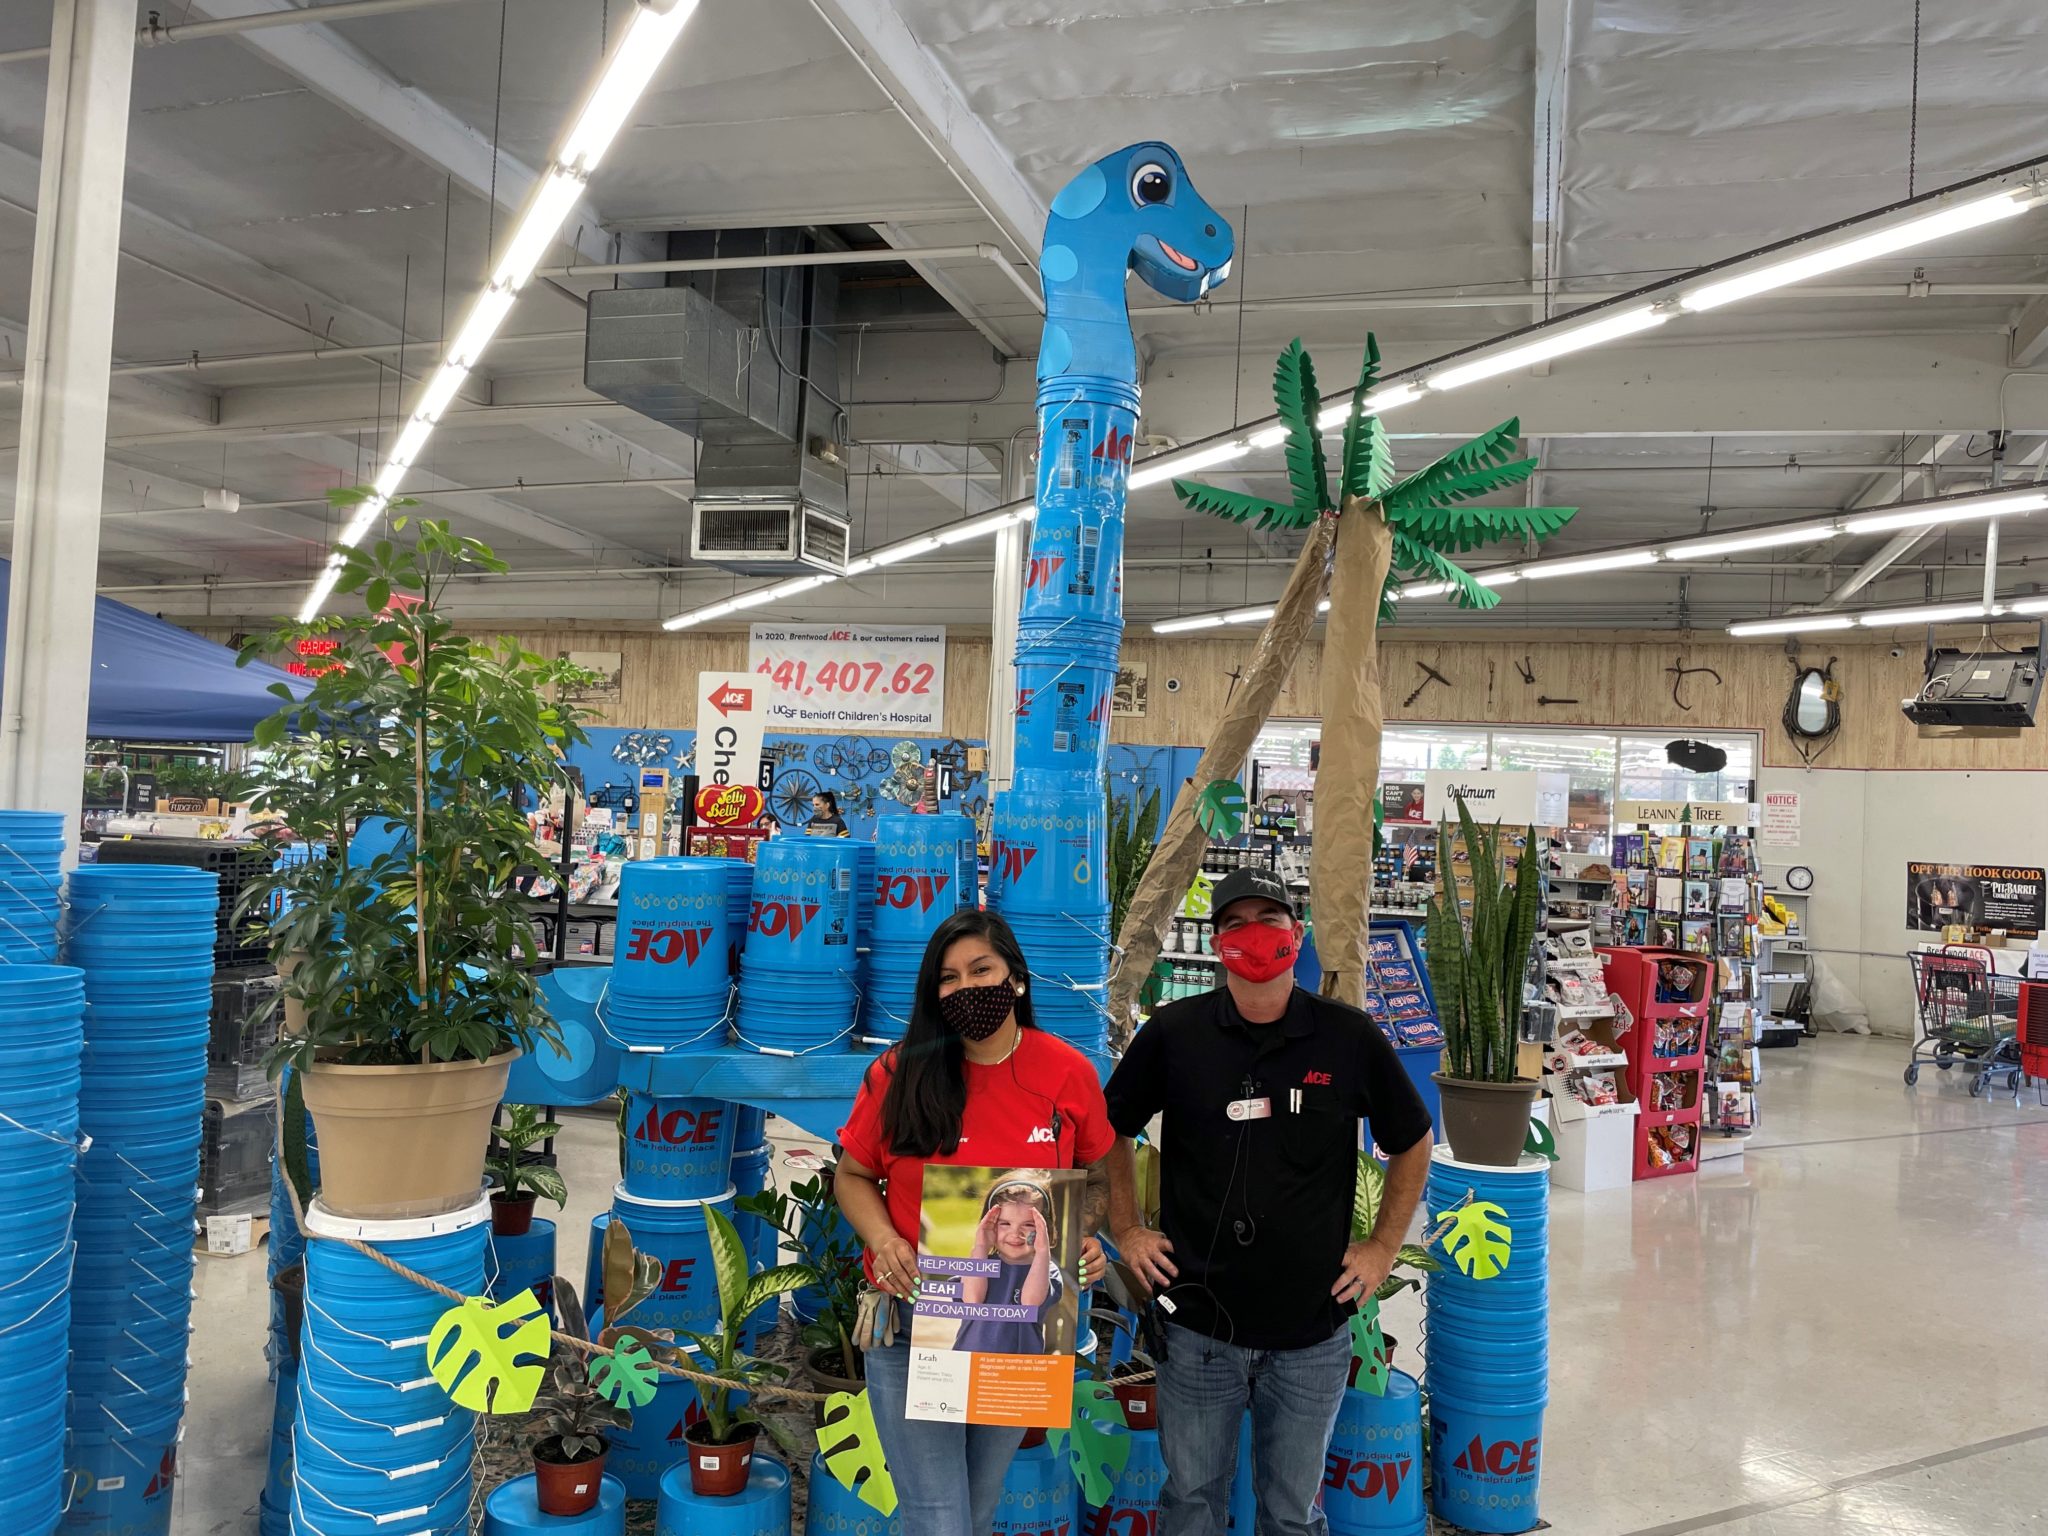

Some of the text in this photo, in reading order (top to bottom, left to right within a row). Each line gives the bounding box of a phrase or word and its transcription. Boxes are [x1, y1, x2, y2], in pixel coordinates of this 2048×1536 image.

[1092, 426, 1133, 465] AC
[765, 633, 787, 641] 2020,
[789, 633, 828, 642] Brentwood
[829, 630, 851, 641] ACE
[874, 635, 913, 643] customers
[915, 635, 940, 643] raised
[721, 692, 745, 704] ACE
[773, 705, 797, 719] UCSF
[800, 710, 836, 720] Benioff
[837, 711, 888, 722] Children's
[890, 712, 932, 724] Hospital
[762, 765, 771, 788] 5
[942, 771, 950, 795] 4
[717, 790, 747, 807] Jelly
[1767, 795, 1797, 805] NOTICE
[706, 803, 741, 819] Belly
[1694, 806, 1722, 820] TREE
[1910, 864, 2043, 881] OFF THE HOOK GOOD.
[875, 874, 950, 914] ACE
[658, 919, 693, 928] helpful
[748, 901, 822, 943] ACE
[626, 927, 714, 969] ACE
[1275, 945, 1291, 960] ACE
[1969, 951, 1984, 959] ACE
[1303, 1070, 1332, 1085] ACE
[634, 1104, 723, 1144] ACE
[635, 1140, 715, 1153] The helpful place
[918, 1258, 1000, 1273] HELP KIDS LIKE
[921, 1282, 956, 1295] LEAH
[915, 1302, 1029, 1319] BY DONATING TODAY
[918, 1353, 938, 1362] Leah
[1355, 1450, 1393, 1462] helpful
[1395, 1451, 1411, 1459] The
[1452, 1434, 1539, 1476] ACE
[1325, 1453, 1412, 1504] ACE
[1454, 1470, 1473, 1480] The
[1476, 1474, 1513, 1484] helpful
[1012, 1519, 1051, 1531] helpful
[1054, 1514, 1070, 1524] The
